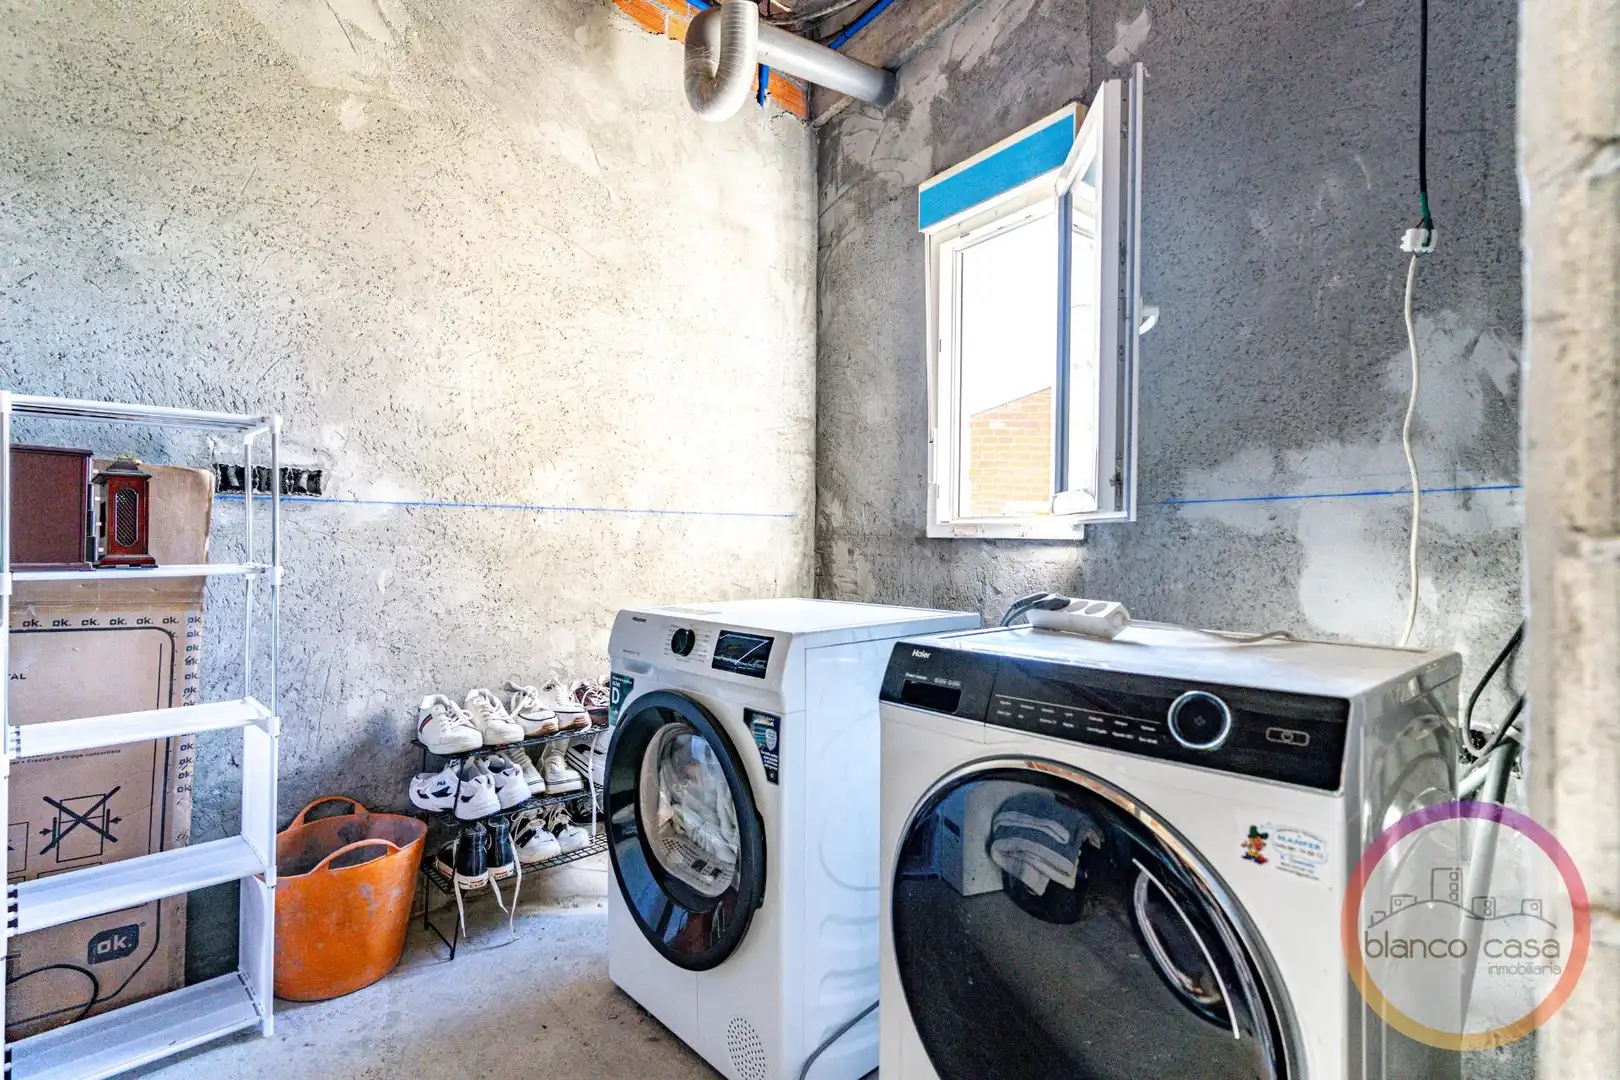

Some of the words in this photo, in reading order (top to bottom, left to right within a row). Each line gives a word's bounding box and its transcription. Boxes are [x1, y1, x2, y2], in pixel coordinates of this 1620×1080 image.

[22, 618, 42, 627] ok.
[52, 618, 71, 627] ok.
[81, 618, 100, 626] ok.
[109, 617, 128, 626] ok.
[136, 617, 153, 625] ok.
[162, 616, 179, 624] ok.
[912, 649, 931, 659] Haier
[611, 686, 620, 705] D
[61, 753, 83, 761] Fridge
[97, 934, 132, 954] ok.
